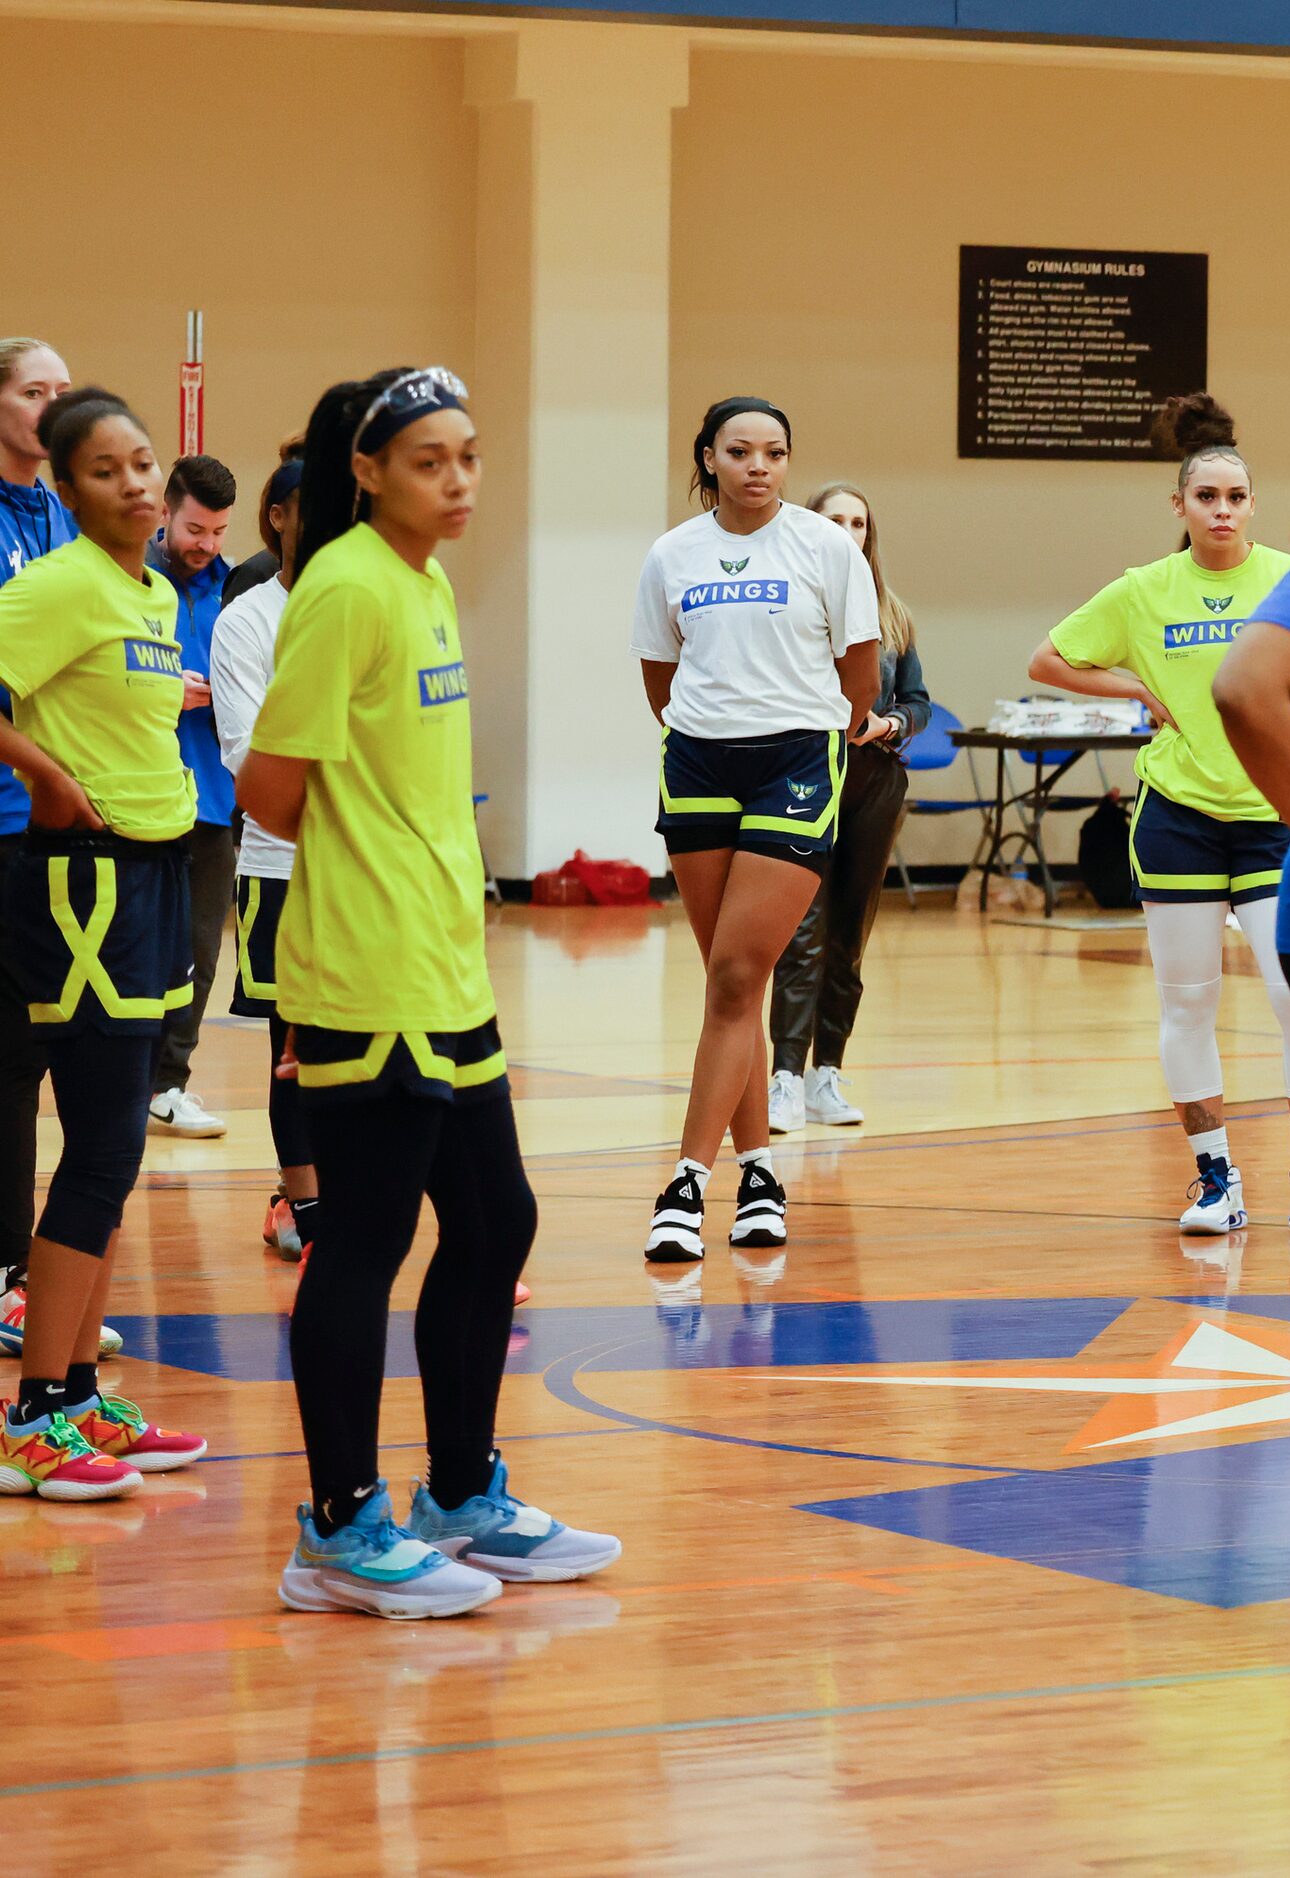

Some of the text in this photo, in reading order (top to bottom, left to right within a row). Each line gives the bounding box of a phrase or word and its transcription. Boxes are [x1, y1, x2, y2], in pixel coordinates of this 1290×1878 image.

[1026, 260, 1145, 276] GYMNASIUM RULES
[689, 583, 779, 605] WINGS
[133, 644, 182, 674] WING
